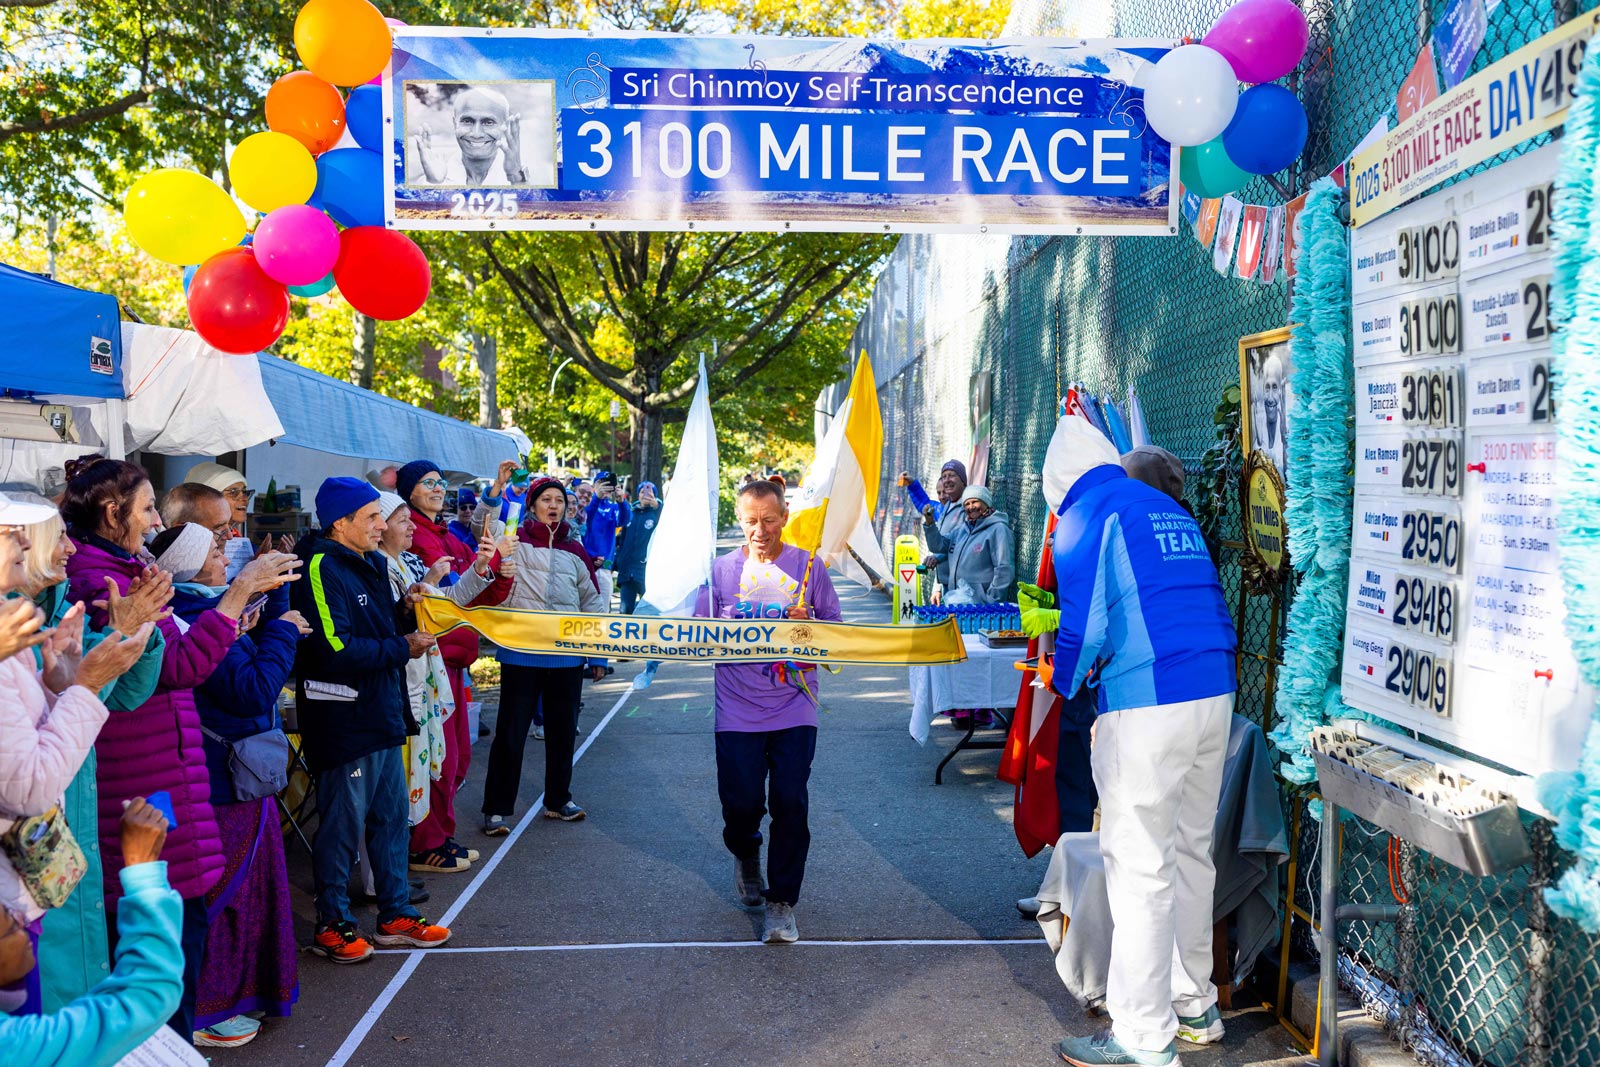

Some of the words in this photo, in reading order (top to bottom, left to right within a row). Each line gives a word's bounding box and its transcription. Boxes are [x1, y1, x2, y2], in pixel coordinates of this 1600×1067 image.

[623, 73, 659, 97] Sri
[668, 74, 800, 106] Chinmoy
[808, 76, 1083, 106] Self-Transcendence
[1355, 163, 1380, 208] 2025
[1382, 144, 1410, 193] 3,100
[1413, 123, 1441, 174] MILE
[1445, 98, 1482, 155] RACE
[1489, 57, 1540, 139] DAY
[577, 120, 731, 179] 3100
[759, 122, 925, 182] MILE
[952, 126, 1129, 184] RACE
[451, 192, 519, 217] 2025
[1470, 219, 1495, 240] Daniela
[1398, 220, 1459, 279] 3100
[1357, 256, 1374, 270] Andrea
[1400, 300, 1458, 354] 3100
[1368, 382, 1397, 396] Mahasatya
[1402, 374, 1454, 425] 3061
[1370, 396, 1399, 413] Janczak
[1365, 448, 1377, 461] Alex
[1377, 447, 1399, 462] Ramsey
[1484, 442, 1508, 460] 3100
[1402, 440, 1458, 490] 2979
[1148, 512, 1161, 521] SRI
[1263, 508, 1279, 528] Miles
[1364, 511, 1381, 526] Adrian
[1382, 512, 1398, 528] Papuc
[1155, 532, 1209, 554] TEAM
[1402, 512, 1459, 568] 2950
[1366, 569, 1381, 584] Milan
[1476, 575, 1503, 590] ADRIAN
[1510, 580, 1525, 594] Sun.
[1358, 583, 1386, 603] Javornicky
[1392, 576, 1452, 636] 2948
[1475, 596, 1497, 610] MILAN
[1503, 601, 1519, 615] Sun.
[563, 620, 603, 638] 2025
[608, 622, 648, 640] SRI
[659, 623, 776, 643] CHINMOY
[554, 640, 715, 657] SELF-TRANSCENDENCE
[720, 647, 752, 656] 3100
[755, 646, 788, 655] MILE
[792, 646, 828, 656] RACE
[1352, 635, 1370, 653] Lucong
[1370, 641, 1384, 658] Geng
[1385, 645, 1446, 713] 2909
